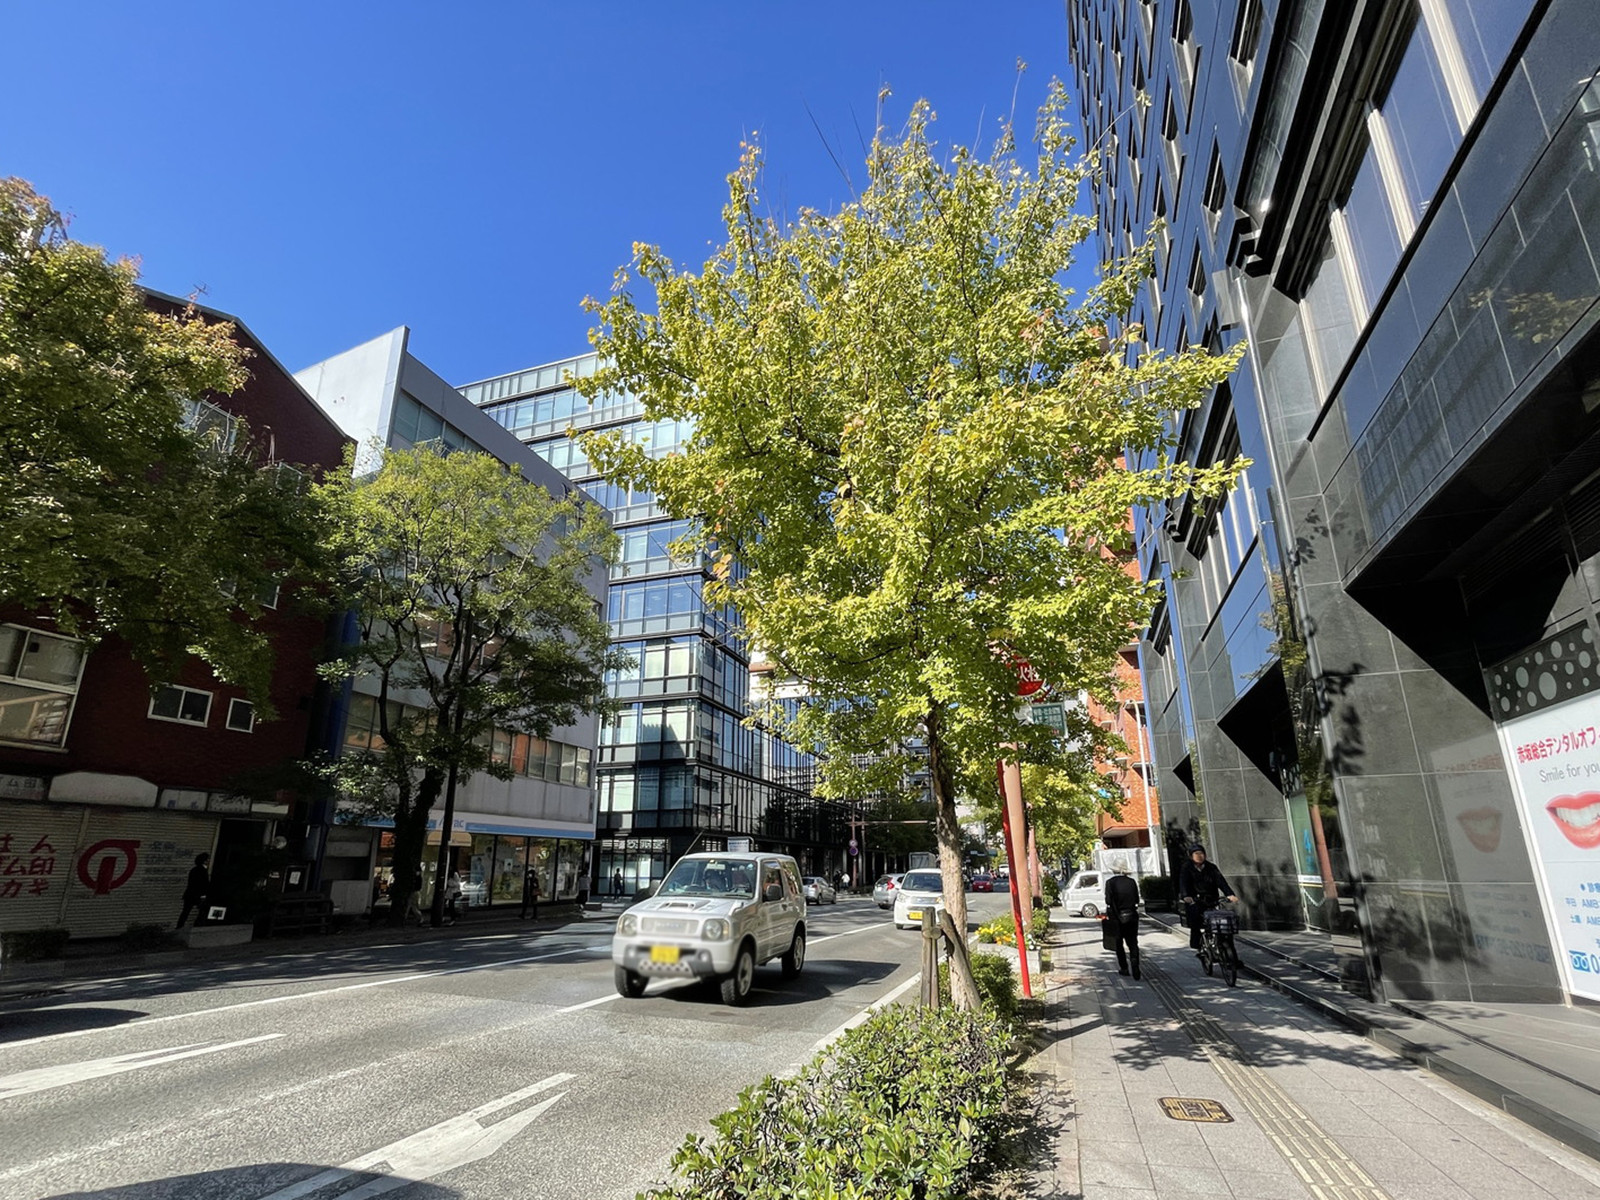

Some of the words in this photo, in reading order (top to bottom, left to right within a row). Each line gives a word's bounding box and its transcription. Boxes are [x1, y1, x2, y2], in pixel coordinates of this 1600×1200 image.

[1517, 726, 1600, 763] 赤坂総合デンタルオフ
[1539, 767, 1565, 783] Smile
[1566, 764, 1581, 778] for
